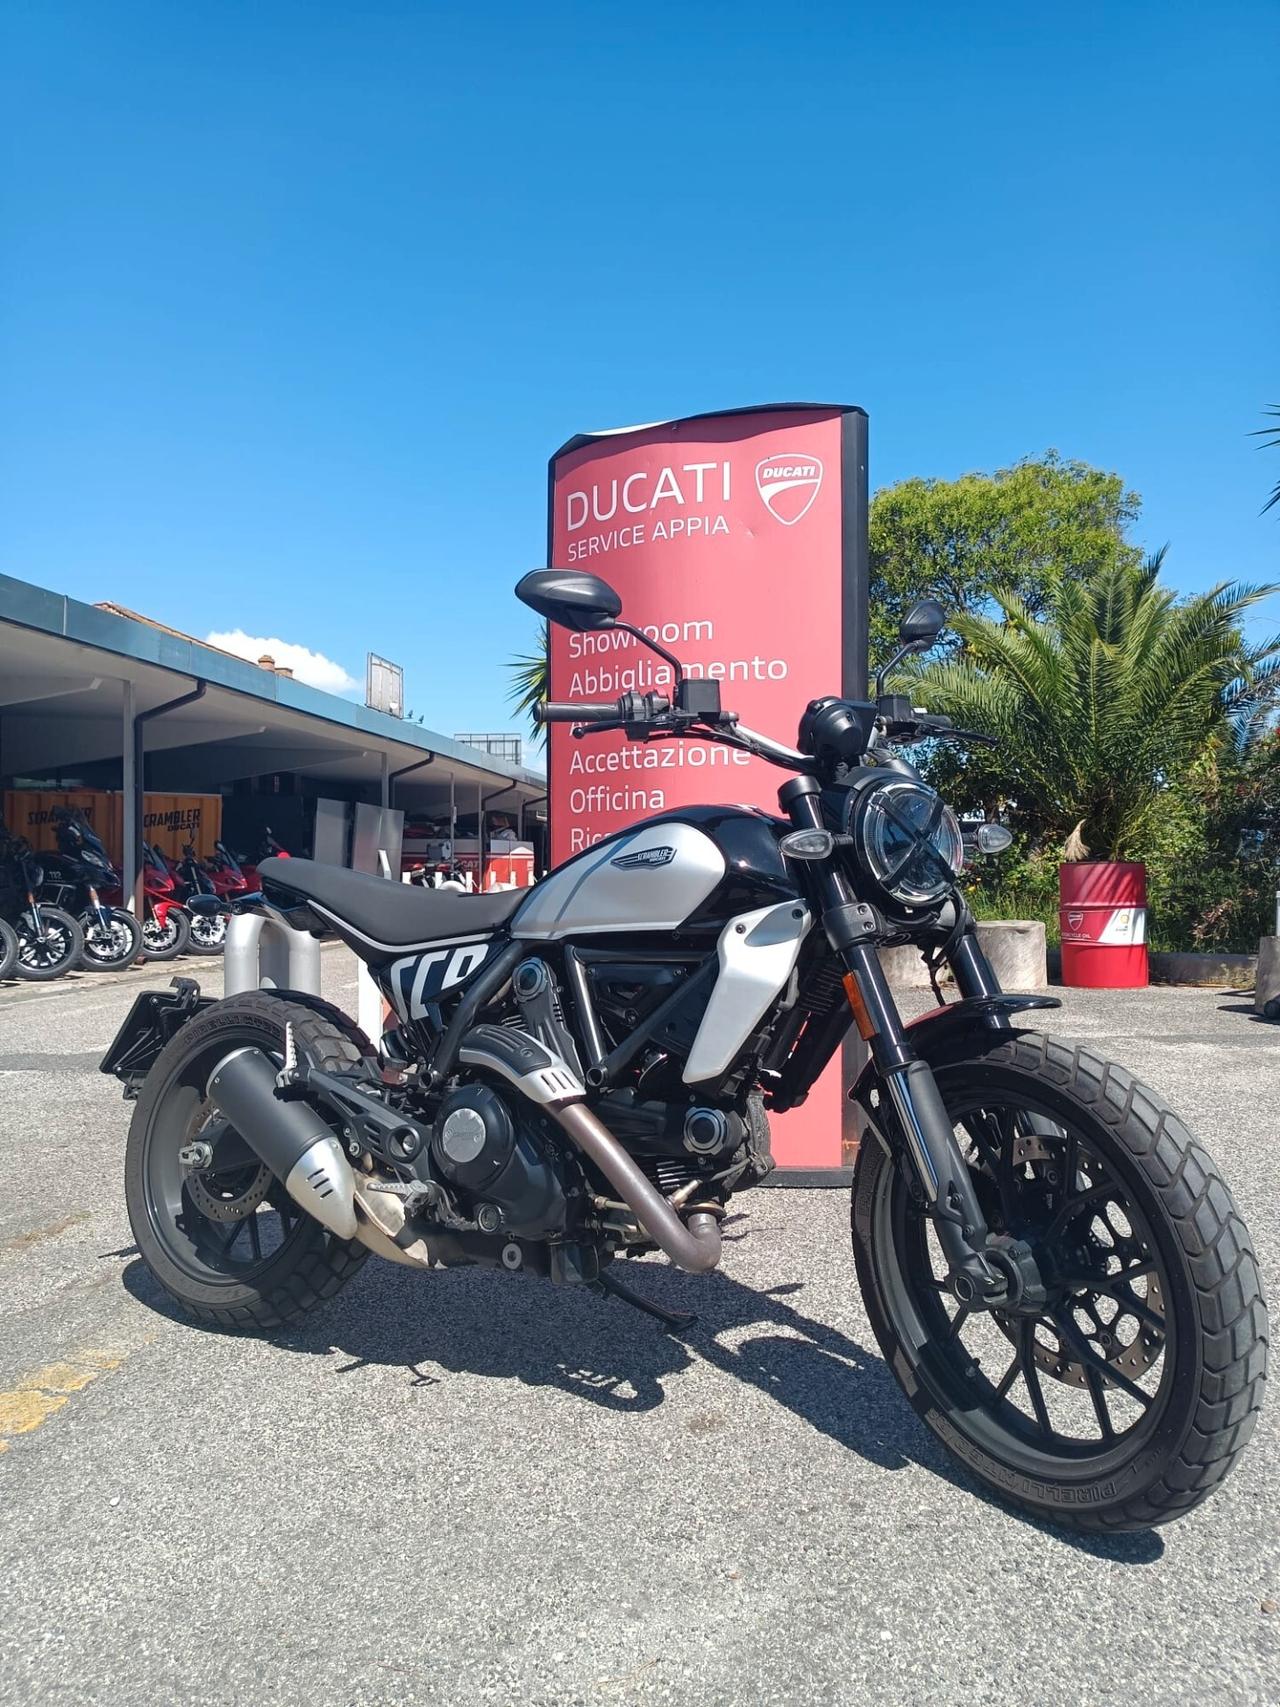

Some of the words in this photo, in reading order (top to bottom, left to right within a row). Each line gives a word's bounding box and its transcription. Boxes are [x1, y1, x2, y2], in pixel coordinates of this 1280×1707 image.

[763, 465, 816, 479] DUCATI
[567, 461, 731, 531] DUCATI
[567, 524, 645, 562] SERVICE
[652, 515, 730, 541] APPIA
[568, 655, 788, 698] Abbigliamento
[569, 740, 750, 775] Accettazione
[569, 784, 665, 814] Officina
[143, 808, 201, 828] CRAMBLER
[1021, 1479, 1118, 1505] PIRELLI
